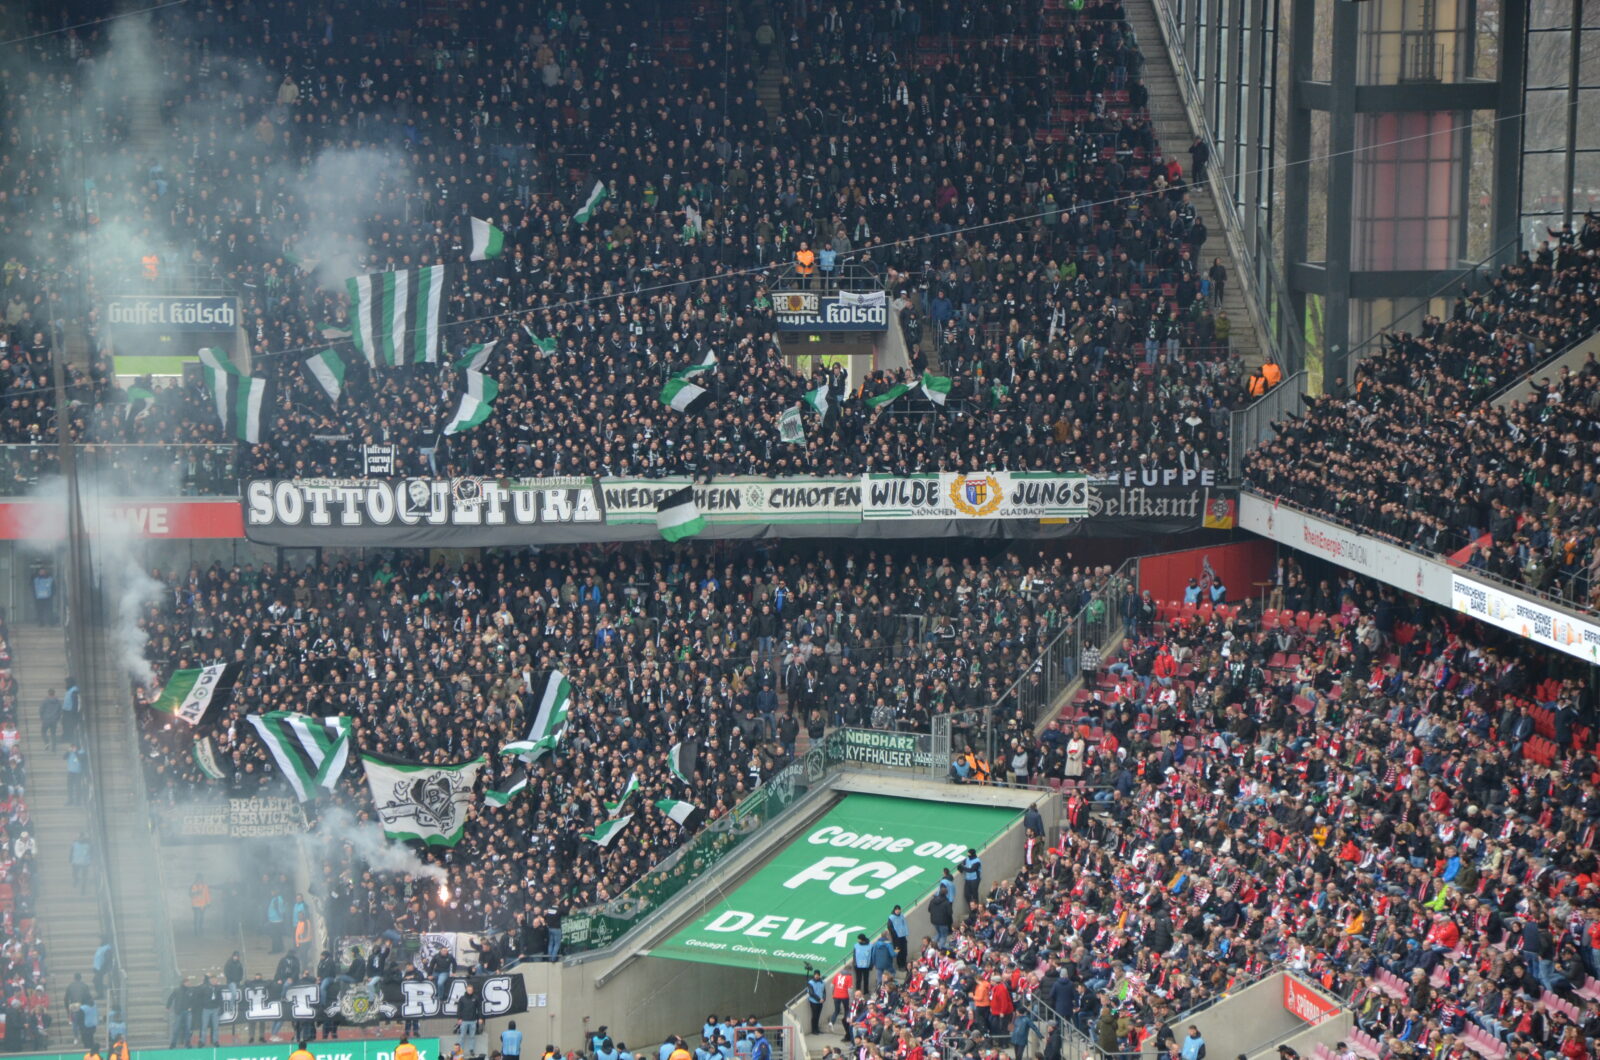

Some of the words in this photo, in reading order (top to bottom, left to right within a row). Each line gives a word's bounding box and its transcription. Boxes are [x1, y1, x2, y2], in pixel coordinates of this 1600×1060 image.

[108, 302, 167, 325] Gaffel
[170, 302, 234, 327] Kölsch
[1124, 469, 1215, 487] FUPPE
[768, 486, 862, 509] CHAOTEN
[870, 480, 940, 507] WILDE
[1011, 480, 1087, 507] JUNGS
[1074, 486, 1200, 523] Selfkant
[1000, 508, 1045, 516] GLADBACH
[1454, 581, 1486, 601] ERFRISCHENDE
[1471, 598, 1486, 614] BANDE
[1516, 604, 1551, 625] ERFRISCHENDE
[1534, 621, 1551, 639] BANDE
[846, 731, 914, 750] NORDHARZ
[808, 826, 894, 853] Come
[913, 841, 968, 863] on,
[783, 856, 926, 899] FC!
[704, 910, 867, 948] DEVK
[685, 938, 728, 950] Gesagt.
[732, 944, 769, 955] Getan.
[773, 949, 828, 963] Geholfen.
